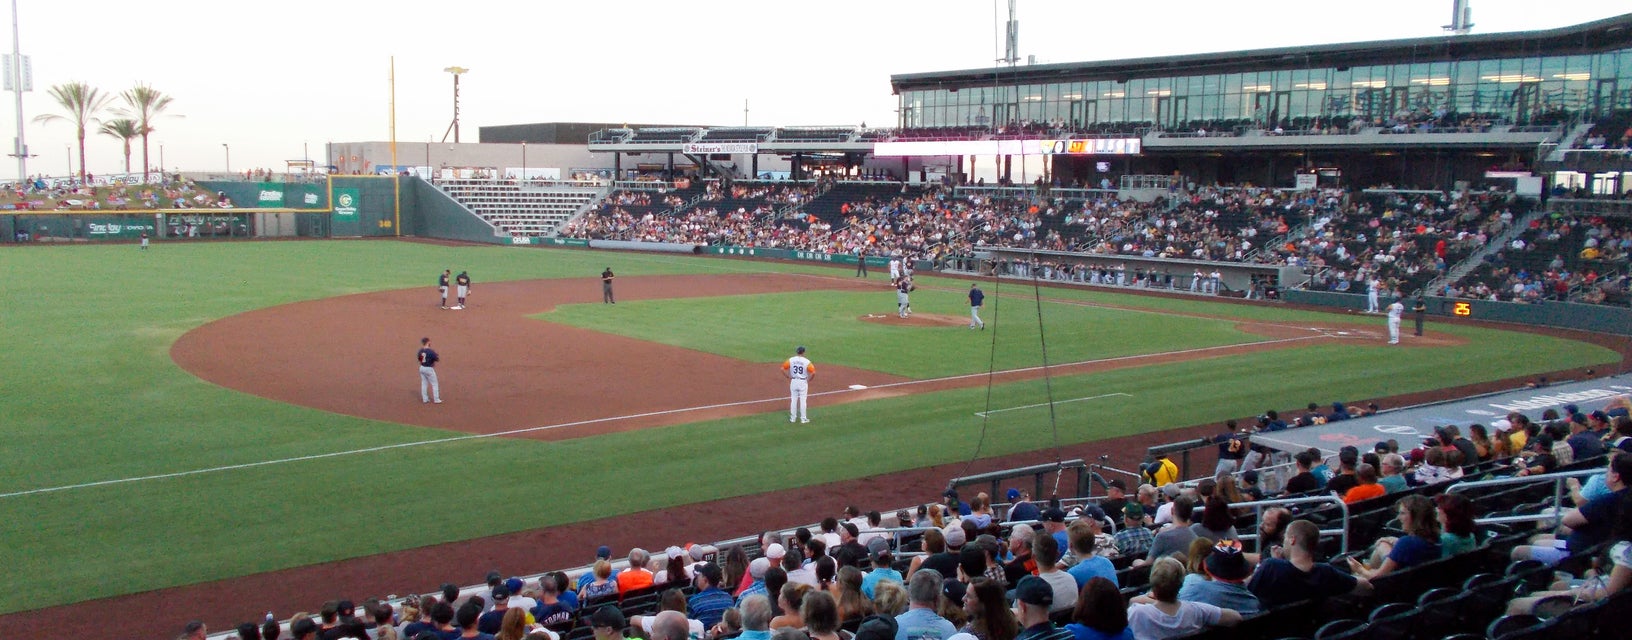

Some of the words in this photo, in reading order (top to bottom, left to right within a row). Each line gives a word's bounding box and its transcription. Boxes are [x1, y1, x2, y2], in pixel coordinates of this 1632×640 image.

[691, 144, 721, 153] Steiner's
[1455, 302, 1470, 315] 25
[793, 365, 804, 375] 39
[1228, 438, 1241, 453] 23
[705, 553, 714, 561] 117
